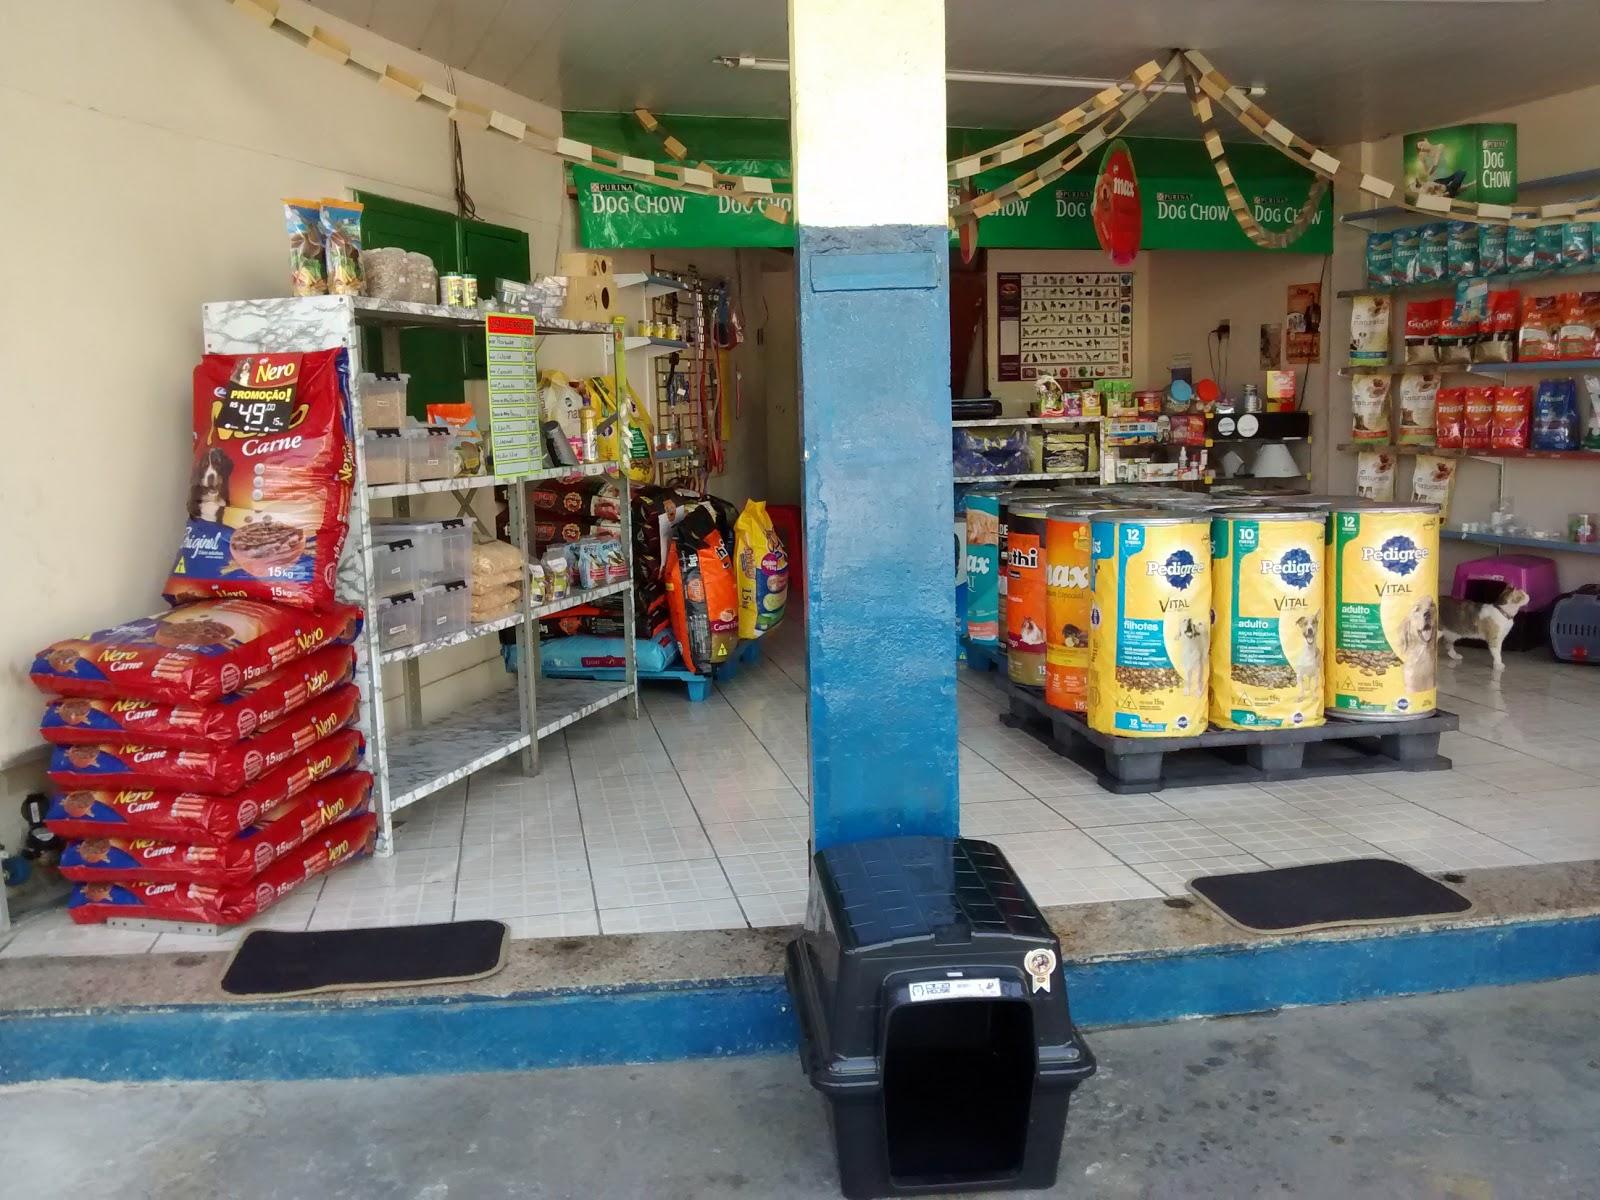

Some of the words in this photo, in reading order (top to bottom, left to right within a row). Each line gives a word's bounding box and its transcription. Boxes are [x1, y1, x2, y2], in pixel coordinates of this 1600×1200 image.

[1483, 150, 1504, 169] DOG
[1482, 170, 1513, 188] CHOW
[1113, 176, 1135, 198] max
[592, 193, 630, 214] DOG
[634, 194, 686, 214] CHOW
[1056, 199, 1086, 217] DOG
[1158, 202, 1187, 219] DOG
[1190, 203, 1231, 221] CHOW
[1254, 205, 1281, 223] DOG
[255, 363, 295, 383] Nero
[230, 388, 292, 402] PROMOÇÃO!
[1439, 404, 1463, 413] max
[1467, 404, 1492, 412] max
[1496, 403, 1524, 412] max
[241, 435, 302, 456] Carne
[1344, 517, 1355, 527] 12
[1126, 529, 1140, 540] 12
[1239, 528, 1254, 540] 10
[1361, 546, 1430, 563] Pedigree
[967, 554, 990, 575] ax
[1146, 561, 1205, 577] Pedigree
[1261, 559, 1319, 576] Pedigree
[268, 567, 294, 579] 15kg
[1047, 564, 1089, 589] ax
[270, 587, 292, 597] 15kg
[1375, 581, 1413, 597] VITAL
[1159, 597, 1190, 613] VITAL
[1273, 596, 1308, 611] VITAL
[1342, 606, 1373, 616] adulto
[1124, 620, 1159, 631] filhotes
[1238, 619, 1269, 628] adulto
[297, 628, 324, 651] Nero
[97, 649, 138, 662] Nero
[110, 661, 143, 672] Carne
[125, 708, 159, 721] Carne
[315, 713, 337, 739] Nero
[133, 750, 167, 763] Carne
[308, 755, 332, 780] Nero
[113, 790, 155, 804] Nero
[127, 800, 160, 813] Carne
[320, 798, 344, 824] Nero
[143, 845, 176, 859] Carne
[145, 882, 177, 896] Carne
